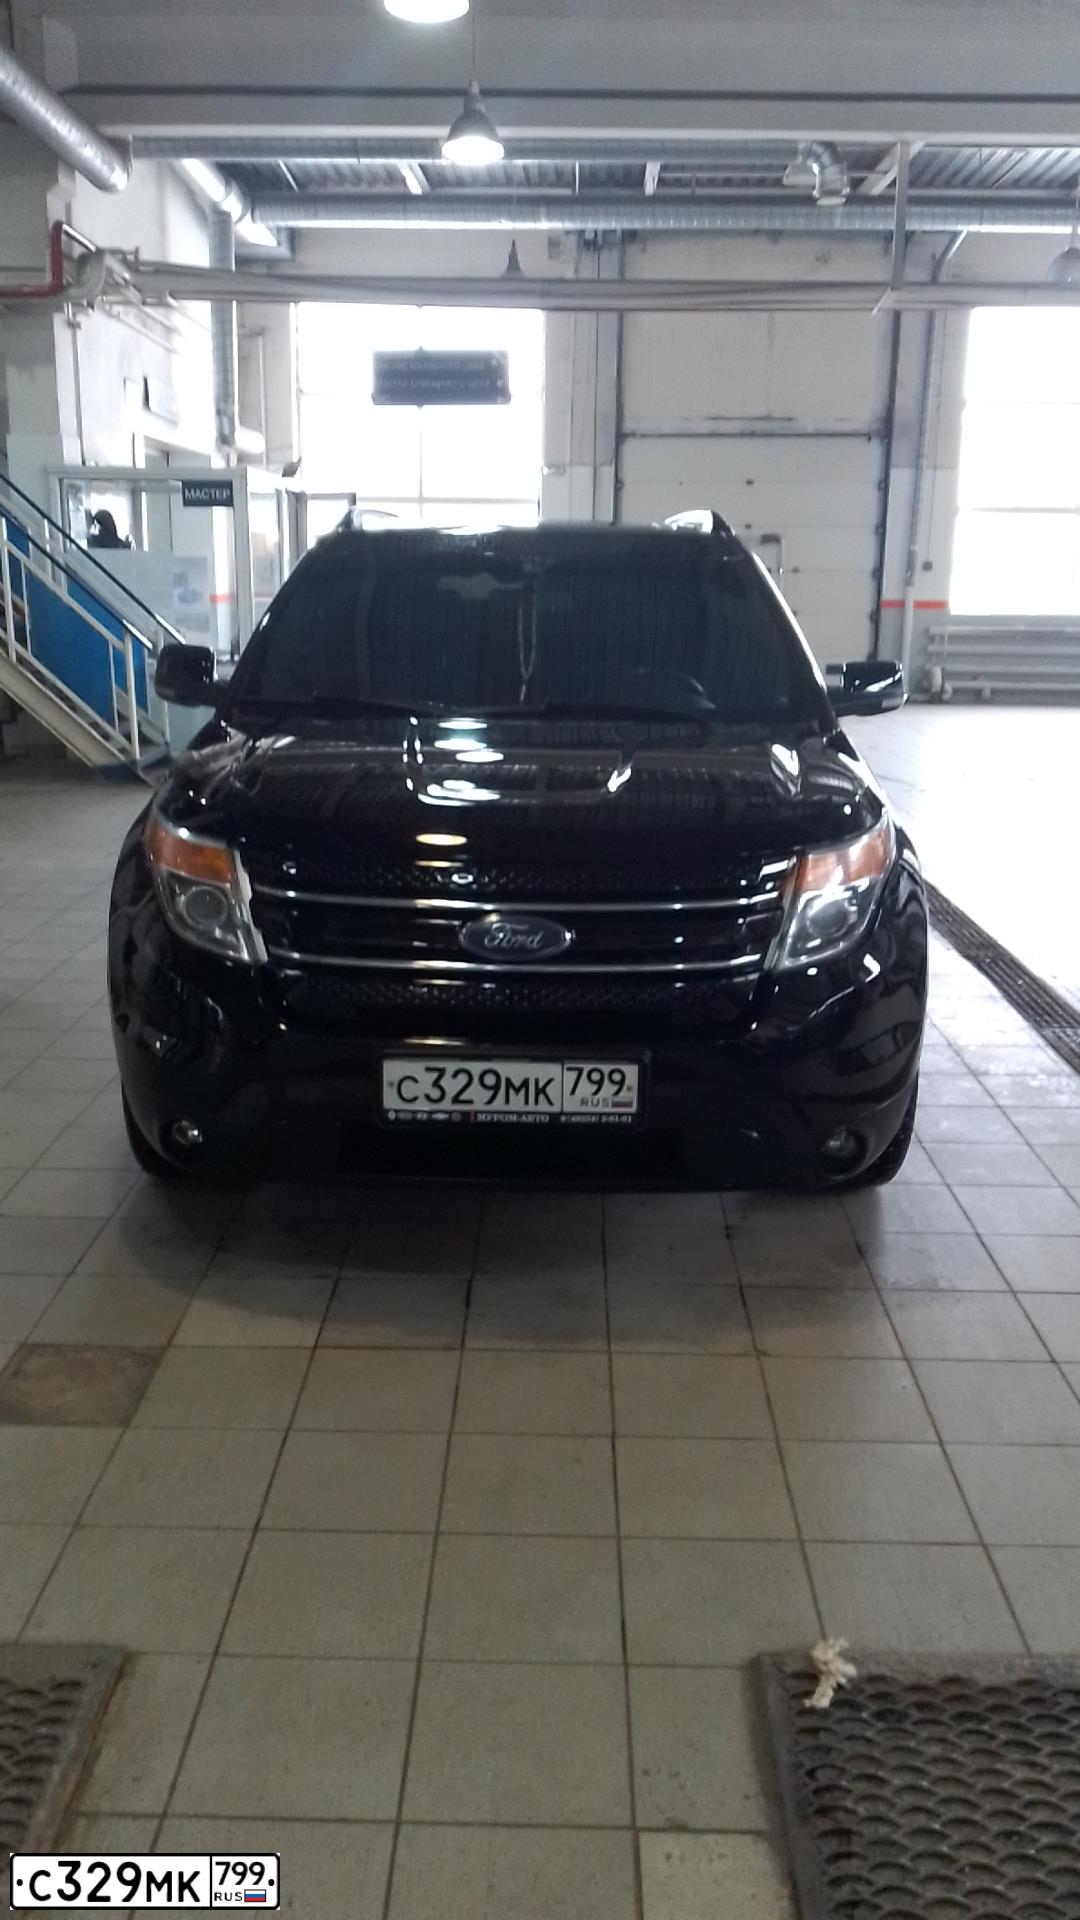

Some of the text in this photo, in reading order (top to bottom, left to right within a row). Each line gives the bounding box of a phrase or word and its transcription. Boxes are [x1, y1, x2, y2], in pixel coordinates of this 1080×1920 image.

[184, 487, 231, 500] МАСТЕР
[484, 922, 544, 949] Ford
[565, 1066, 626, 1097] 799
[580, 1097, 609, 1107] RUS
